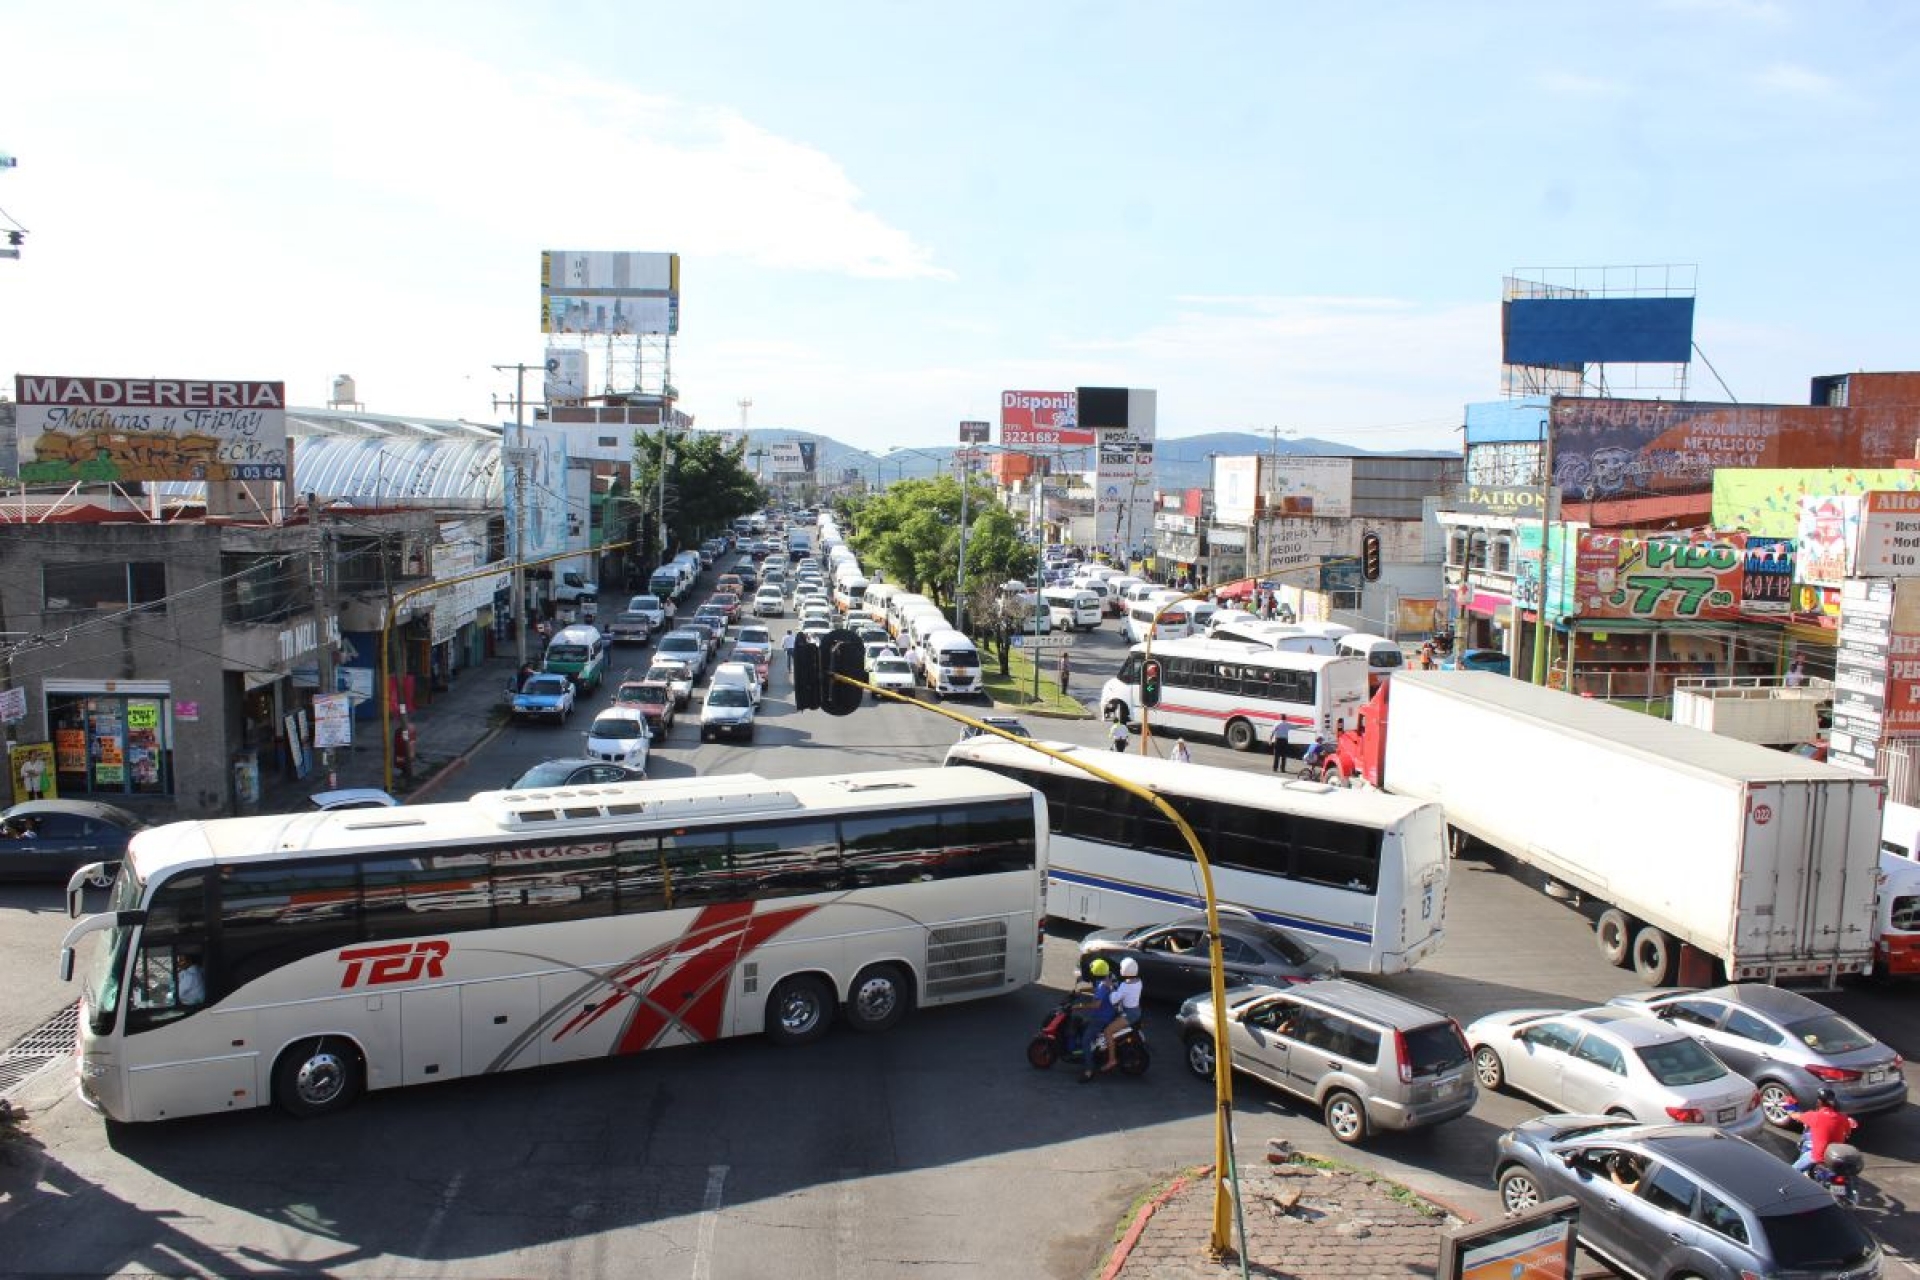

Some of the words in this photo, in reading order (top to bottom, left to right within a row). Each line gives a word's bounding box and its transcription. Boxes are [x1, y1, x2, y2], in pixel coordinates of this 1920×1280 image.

[23, 378, 280, 405] MADERERIA
[183, 408, 263, 435] Triplay
[1004, 431, 1060, 443] 3221682
[1684, 437, 1765, 452] METALICOS
[1101, 454, 1134, 464] HSBC
[1626, 576, 1716, 616] 77
